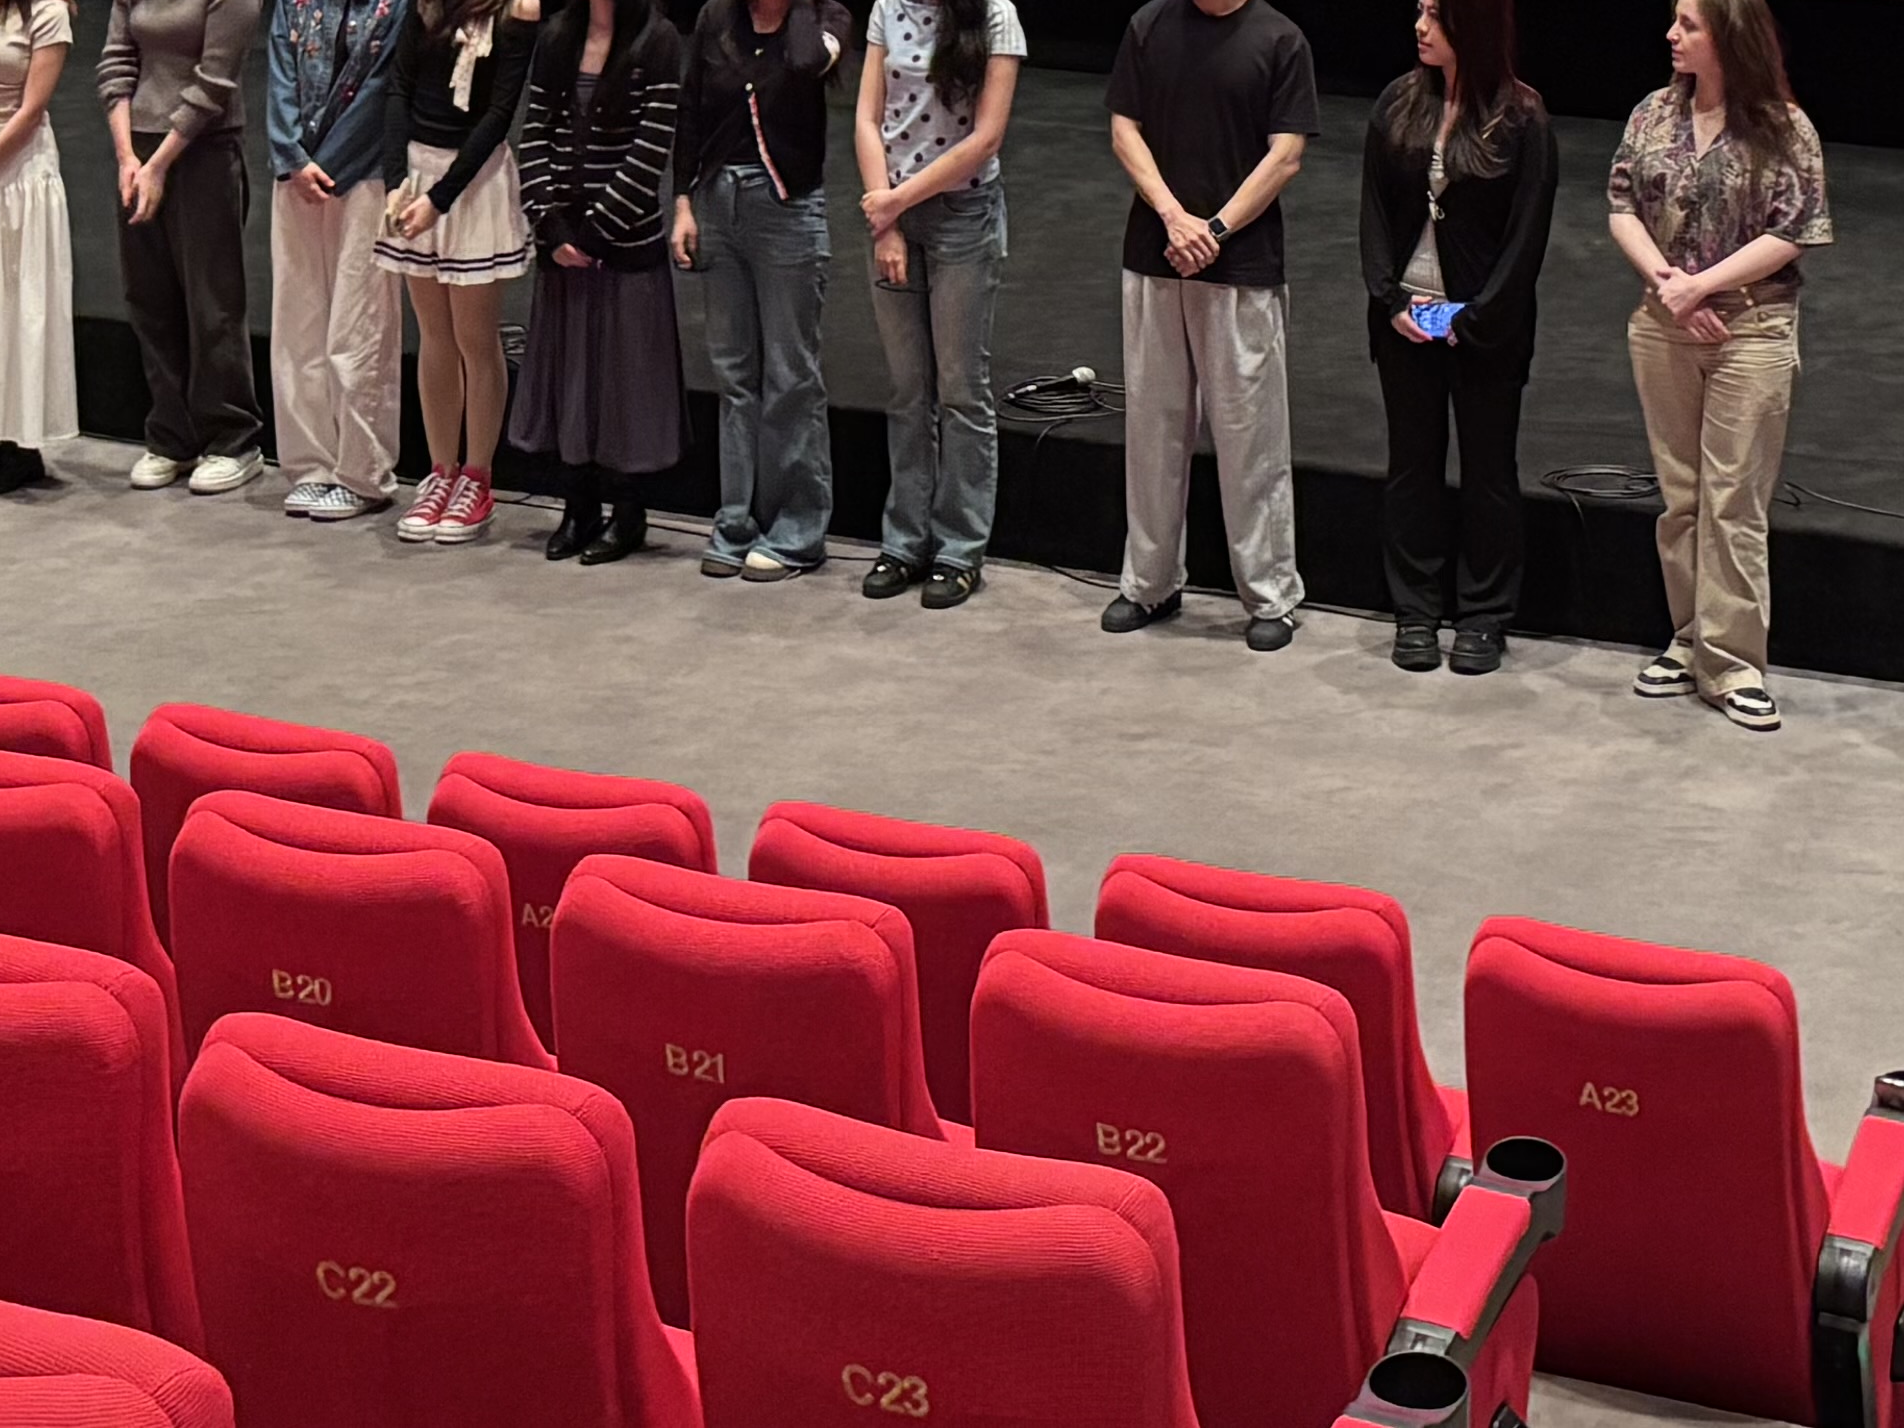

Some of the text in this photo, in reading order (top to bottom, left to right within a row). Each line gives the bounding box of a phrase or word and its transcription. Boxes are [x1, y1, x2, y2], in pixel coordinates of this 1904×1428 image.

[272, 968, 333, 1008] B20
[664, 1043, 727, 1084] B21
[1579, 1080, 1641, 1118] A23
[1096, 1123, 1169, 1165] B22
[316, 1260, 397, 1310] C22
[841, 1363, 931, 1418] C23
